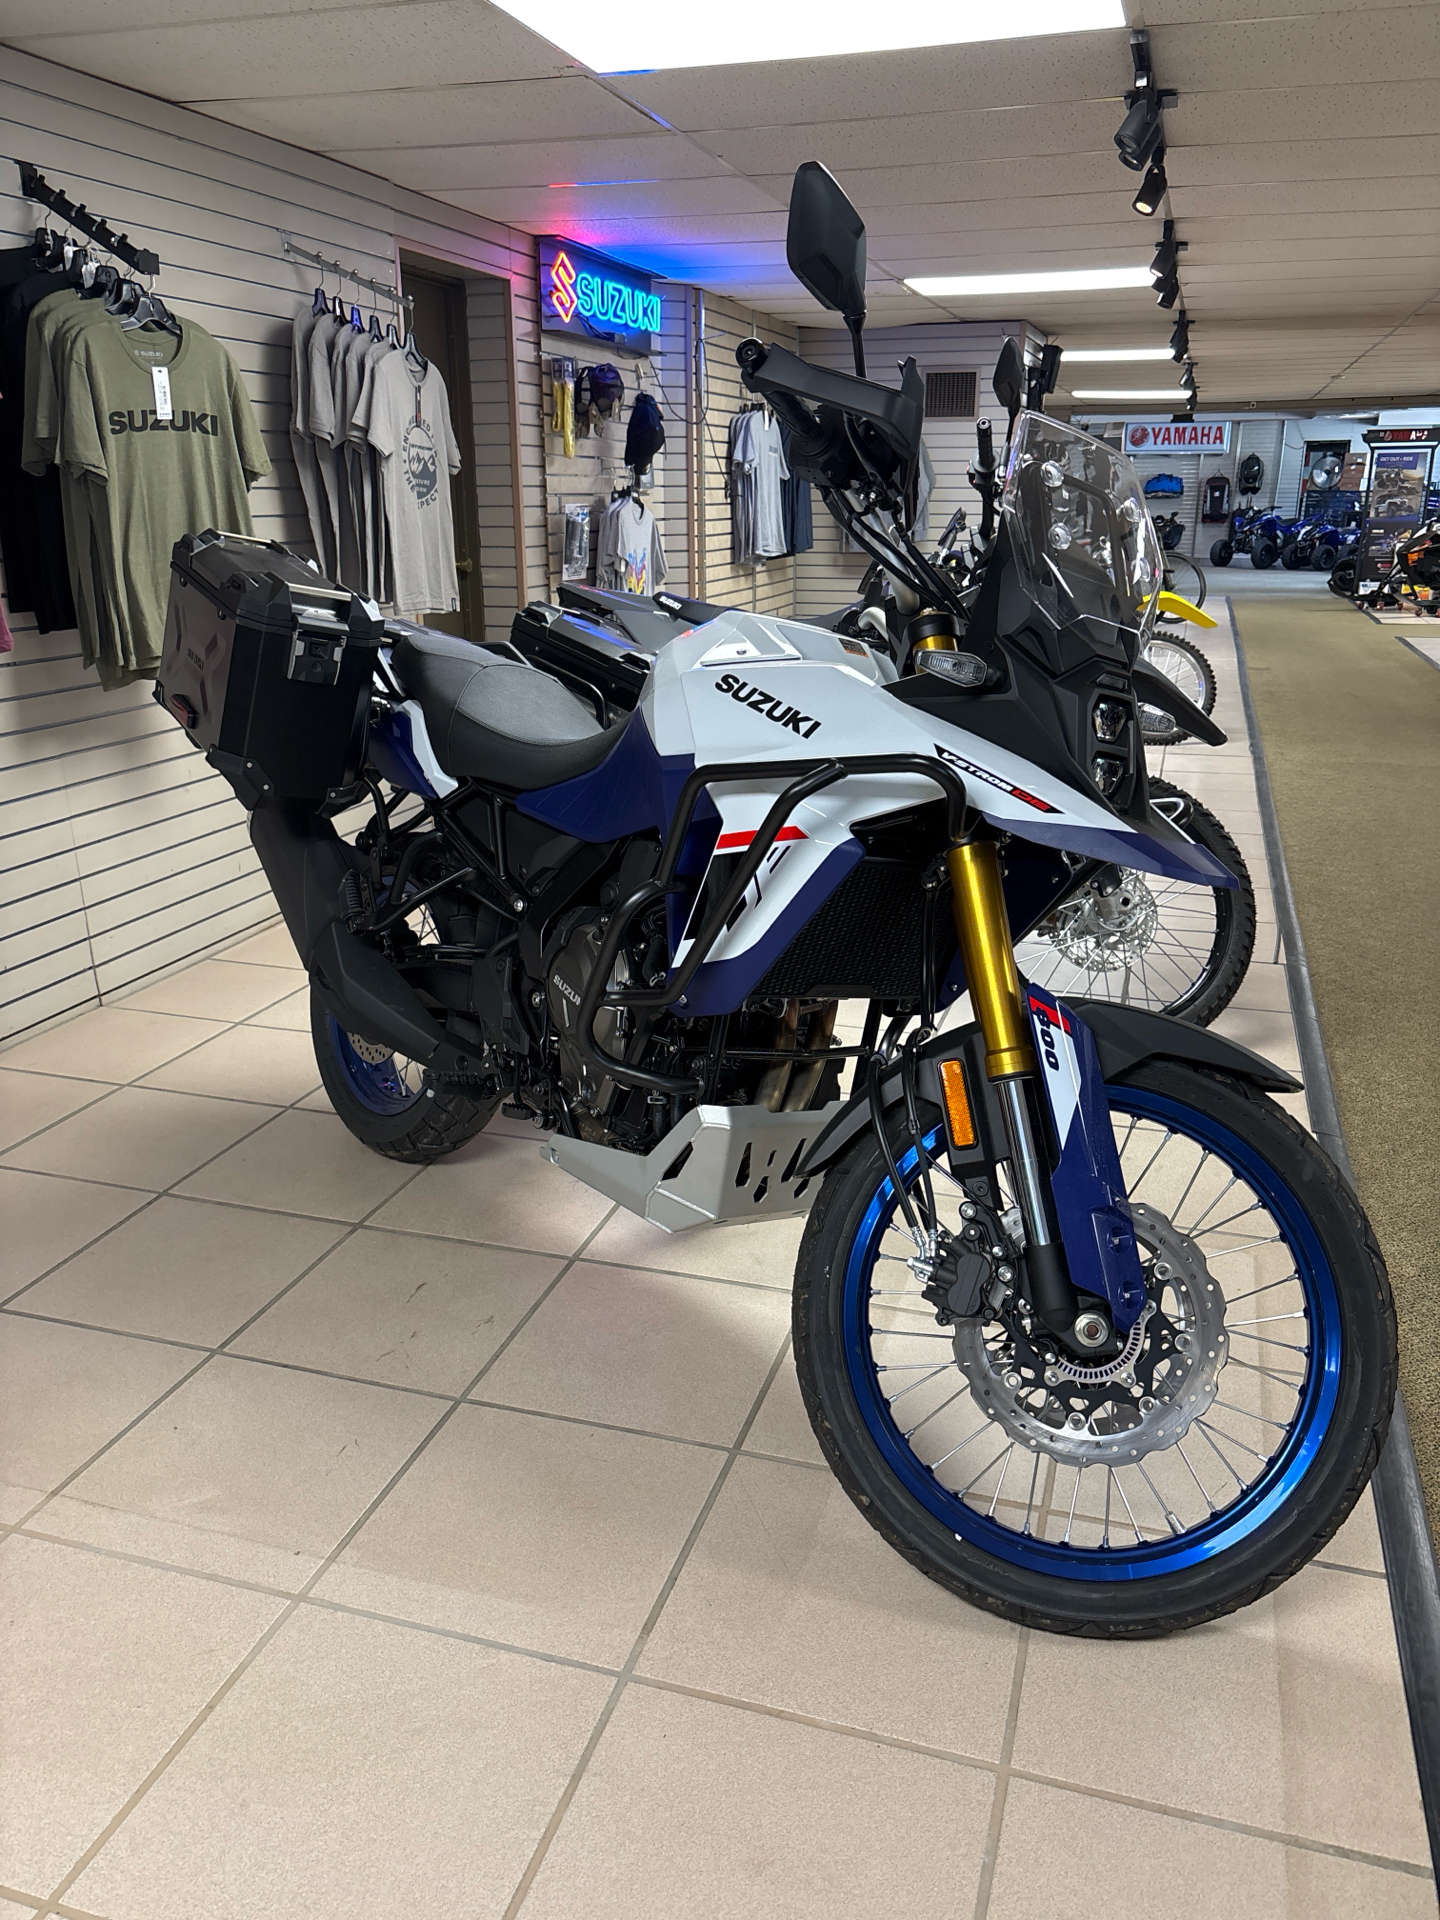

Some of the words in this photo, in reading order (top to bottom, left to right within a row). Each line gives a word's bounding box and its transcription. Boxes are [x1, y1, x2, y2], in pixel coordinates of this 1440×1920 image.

[576, 273, 661, 332] SUZUKI
[1151, 425, 1224, 446] YAMAHA
[714, 673, 823, 740] SUZUKI
[940, 751, 1014, 792] V-STROM
[1011, 789, 1051, 812] DE
[1033, 1006, 1060, 1072] 800
